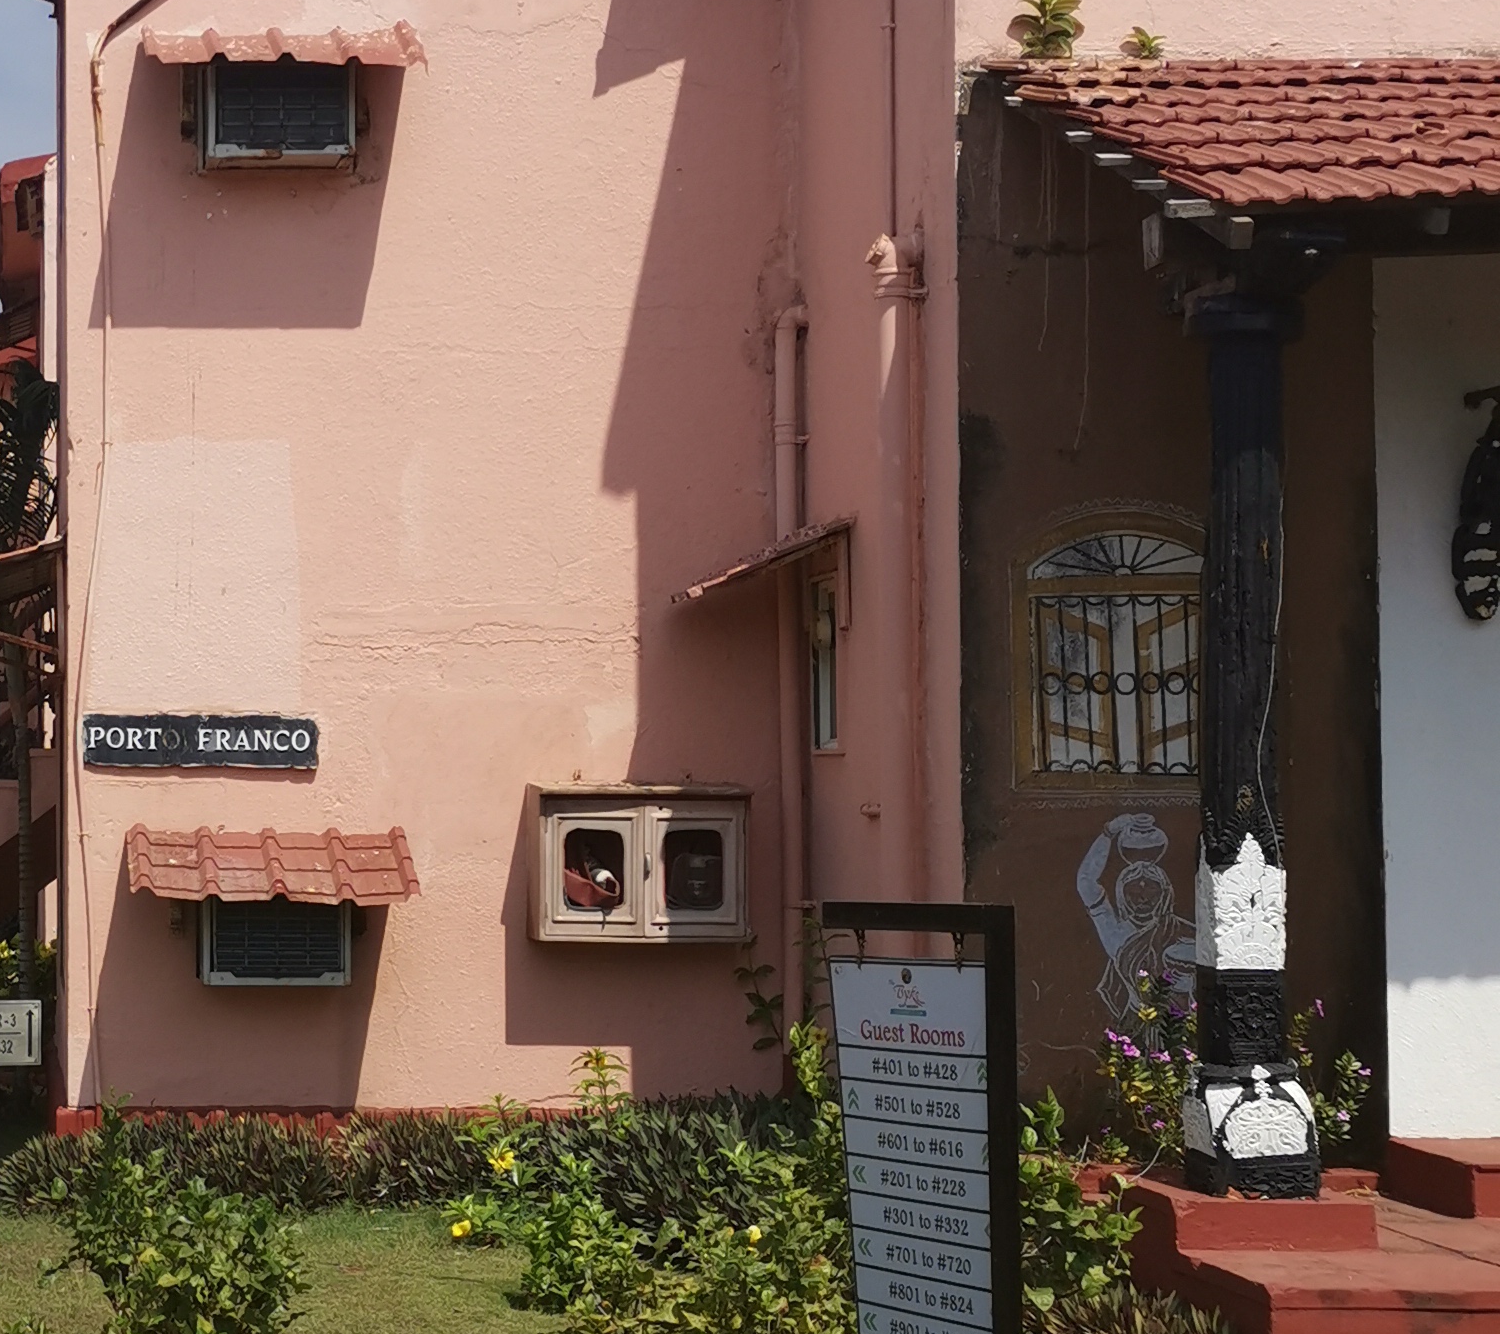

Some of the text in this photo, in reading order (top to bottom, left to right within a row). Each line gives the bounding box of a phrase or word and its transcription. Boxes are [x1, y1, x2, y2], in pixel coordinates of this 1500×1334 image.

[197, 728, 311, 752] FRANCO
[860, 1019, 966, 1048] Guest Rooms
[872, 1058, 958, 1081] #401 to #428
[875, 1095, 961, 1119] #501 to #528
[878, 1132, 963, 1158] #601 to #616
[880, 1169, 966, 1197] #201 to #228
[883, 1206, 970, 1236] #301 to #332
[886, 1244, 971, 1275] #701 to #720
[889, 1281, 974, 1315] #801 to #824
